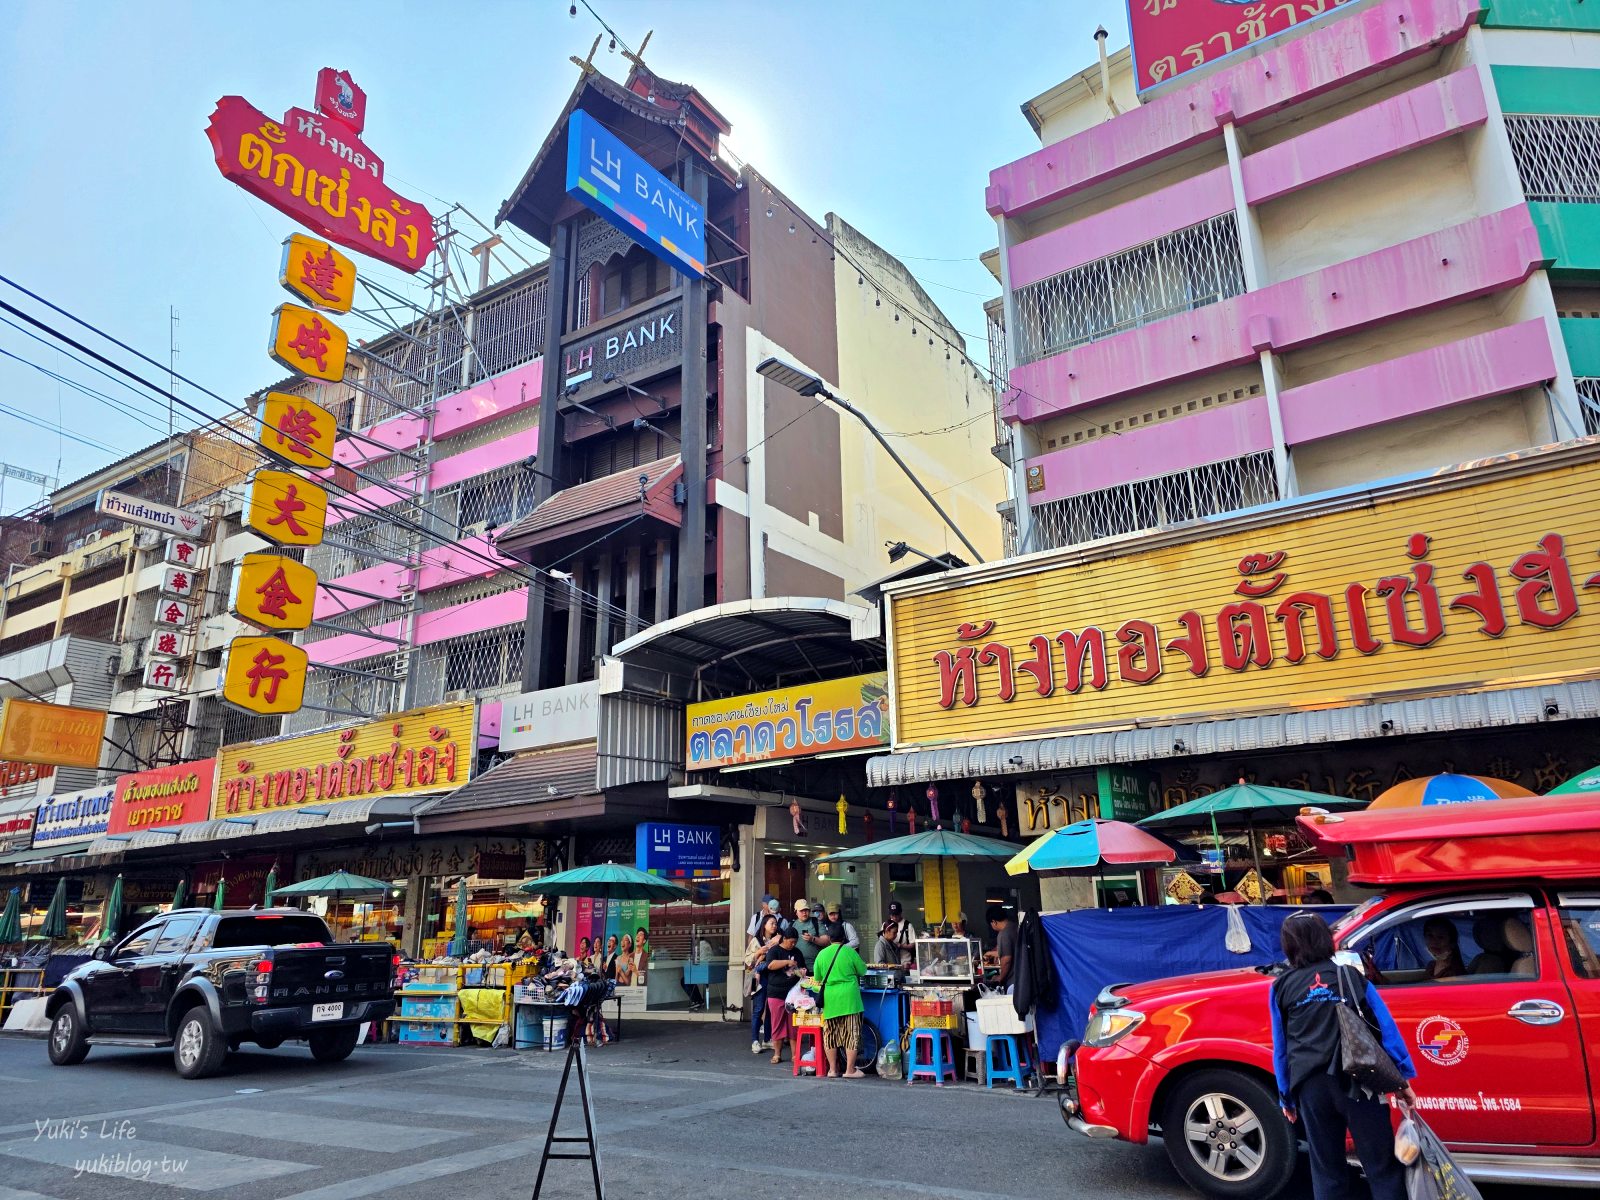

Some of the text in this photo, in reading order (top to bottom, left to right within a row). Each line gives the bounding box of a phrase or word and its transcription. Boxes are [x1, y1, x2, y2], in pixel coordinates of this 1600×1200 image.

[297, 116, 378, 178] ห้างทอง
[591, 138, 621, 180] LH
[635, 173, 698, 239] BANK
[566, 313, 674, 375] LH BANK
[513, 694, 590, 722] LH BANK
[690, 697, 883, 763] ตลาดวโรรส
[692, 697, 789, 727] กาดของคนเชียงใหม่
[654, 828, 714, 844] LH BANK
[273, 982, 385, 997] RANGER
